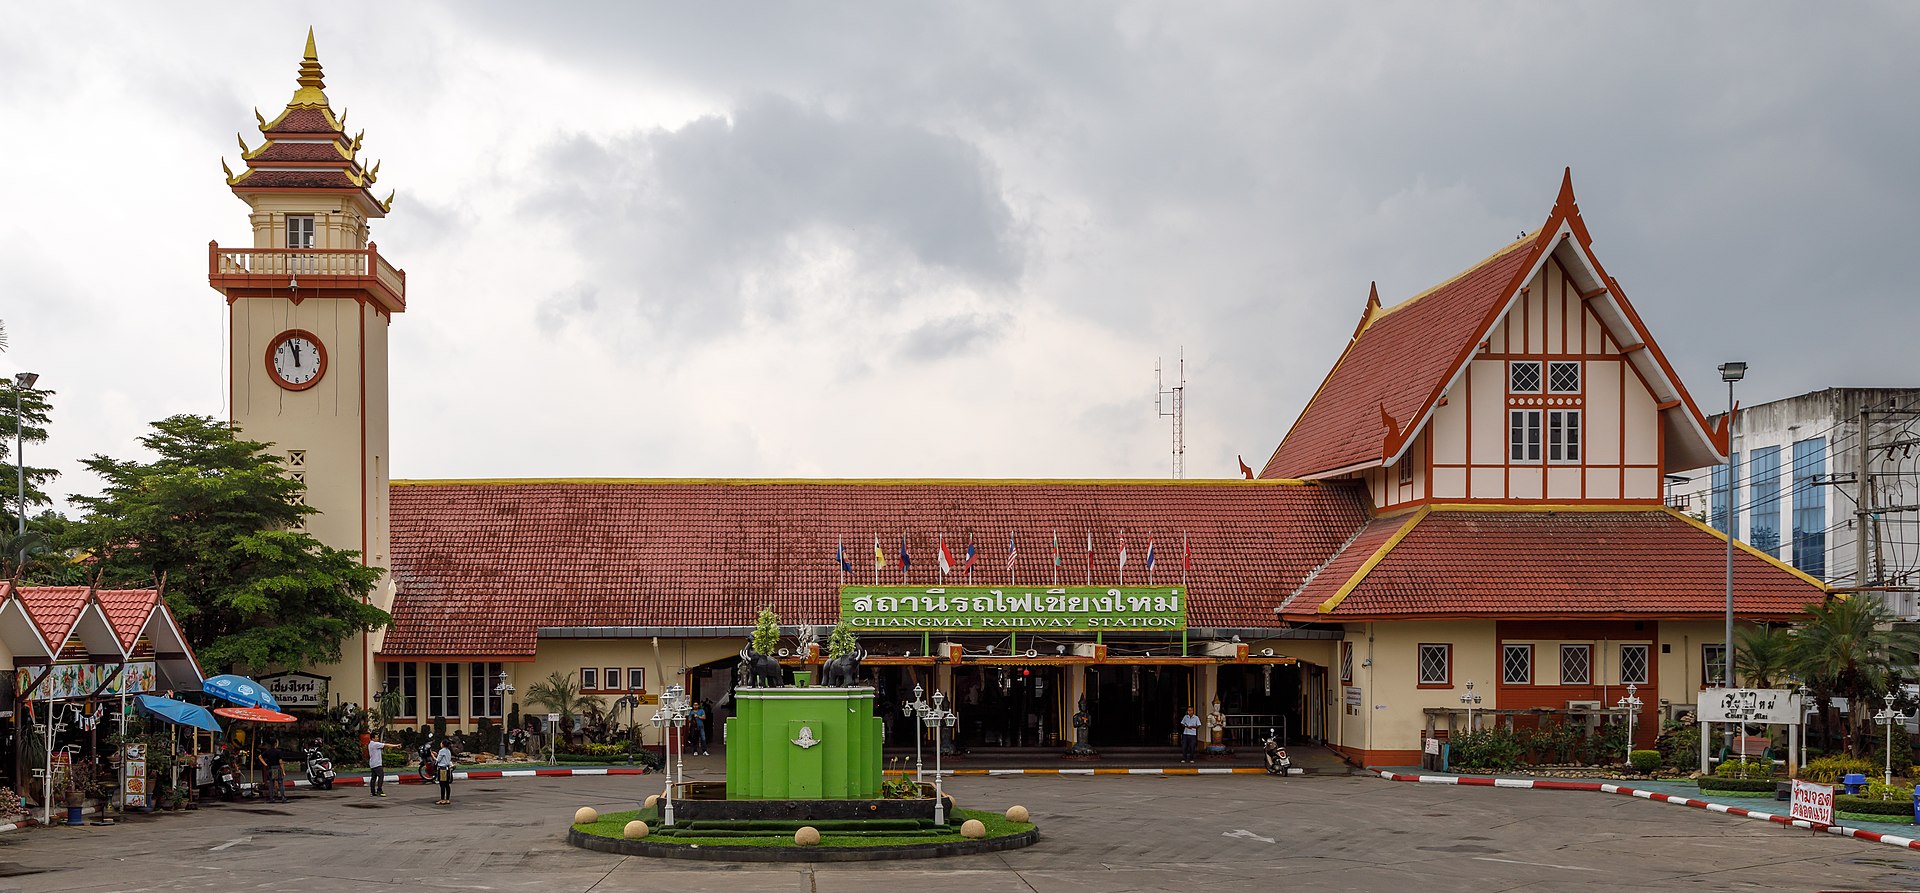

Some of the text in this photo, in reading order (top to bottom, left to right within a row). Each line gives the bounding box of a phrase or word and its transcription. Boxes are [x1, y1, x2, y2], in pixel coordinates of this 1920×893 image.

[852, 588, 1178, 612] สถานีรถไฟเชียงใหม่
[851, 617, 1178, 627] CHIANGMAI RAILWAY STATION
[272, 694, 317, 703] hiang Mai
[1721, 692, 1776, 710] เชียใหม่
[1753, 712, 1768, 720] Mai
